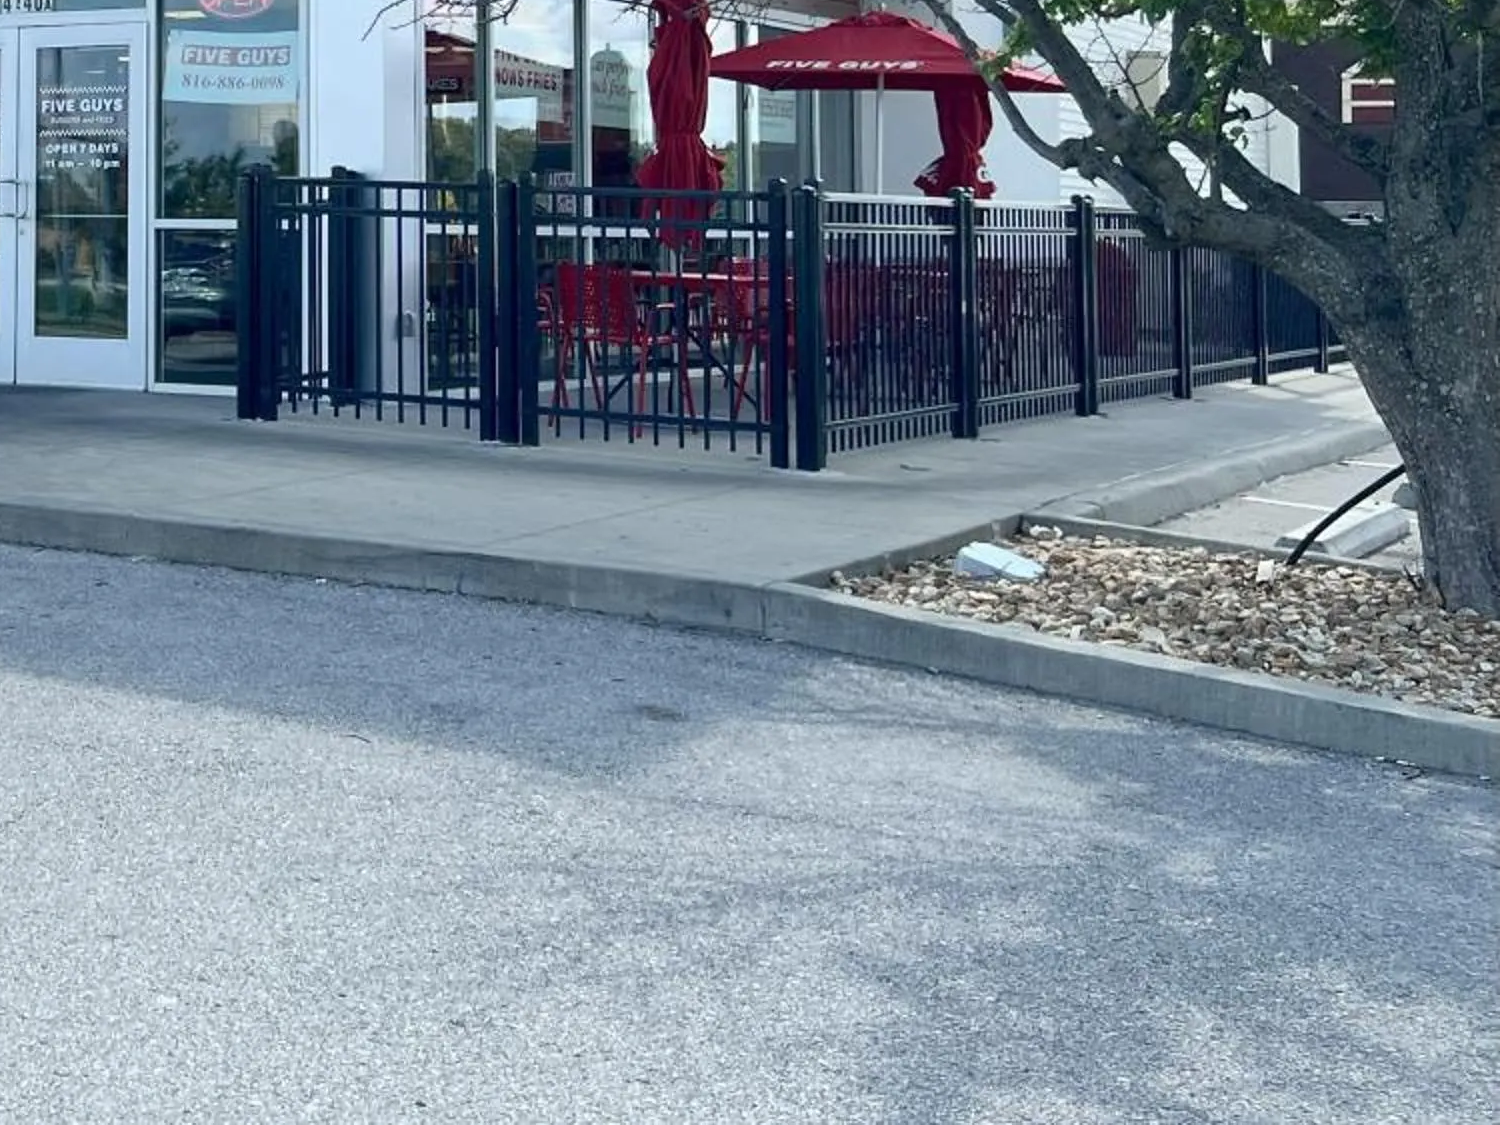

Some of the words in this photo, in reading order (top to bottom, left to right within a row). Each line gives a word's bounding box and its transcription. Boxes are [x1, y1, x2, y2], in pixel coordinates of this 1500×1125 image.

[183, 46, 232, 64] FIVE
[236, 47, 289, 65] GUYS
[765, 60, 832, 69] FIVE
[837, 60, 919, 71] GUYS
[41, 100, 76, 114] FIVE
[80, 98, 124, 112] GUYS
[89, 143, 119, 154] DAYS
